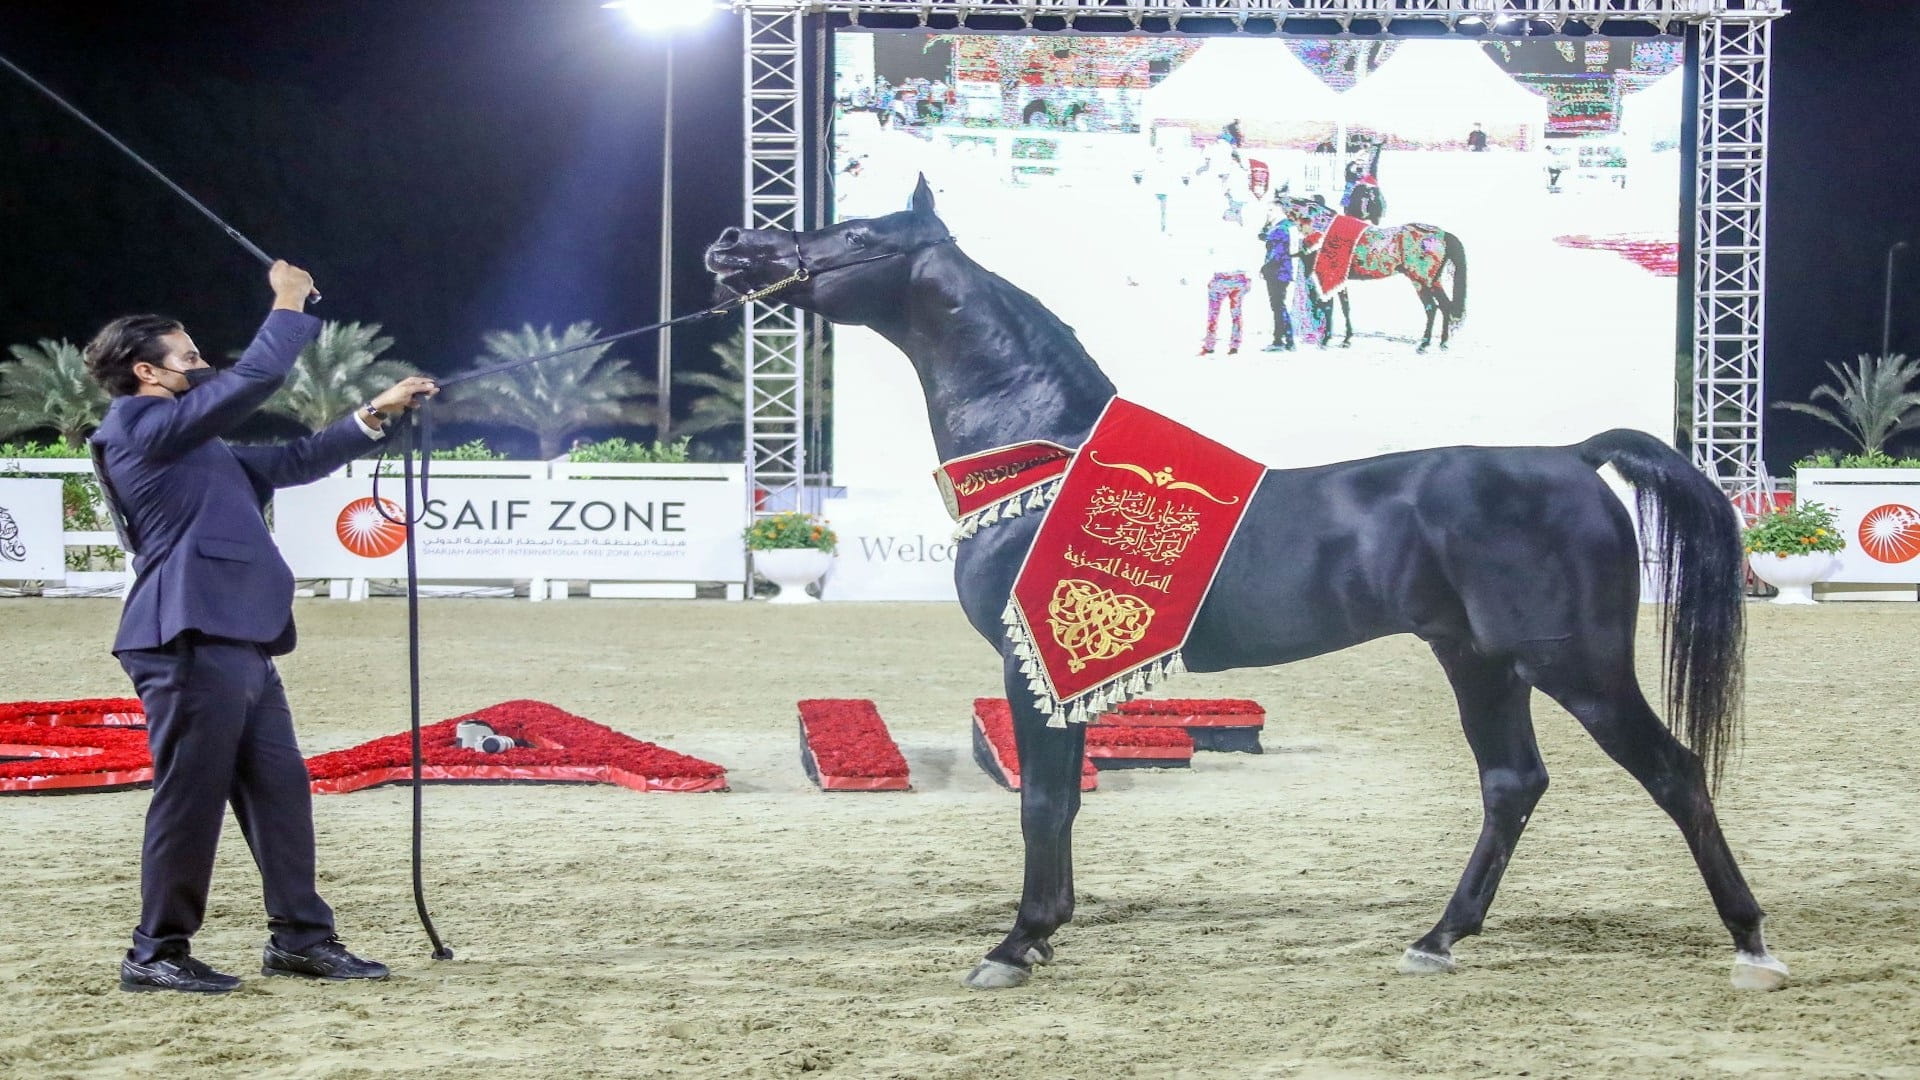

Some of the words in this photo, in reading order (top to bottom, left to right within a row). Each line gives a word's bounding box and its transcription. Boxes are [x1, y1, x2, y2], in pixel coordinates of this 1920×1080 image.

[424, 499, 530, 531] SAIF
[549, 500, 687, 532] ZONE
[466, 548, 505, 556] AIRPORT
[508, 548, 580, 557] INTERNATIONAL
[1063, 544, 1122, 578] المصرية
[1121, 563, 1174, 593] السلالة
